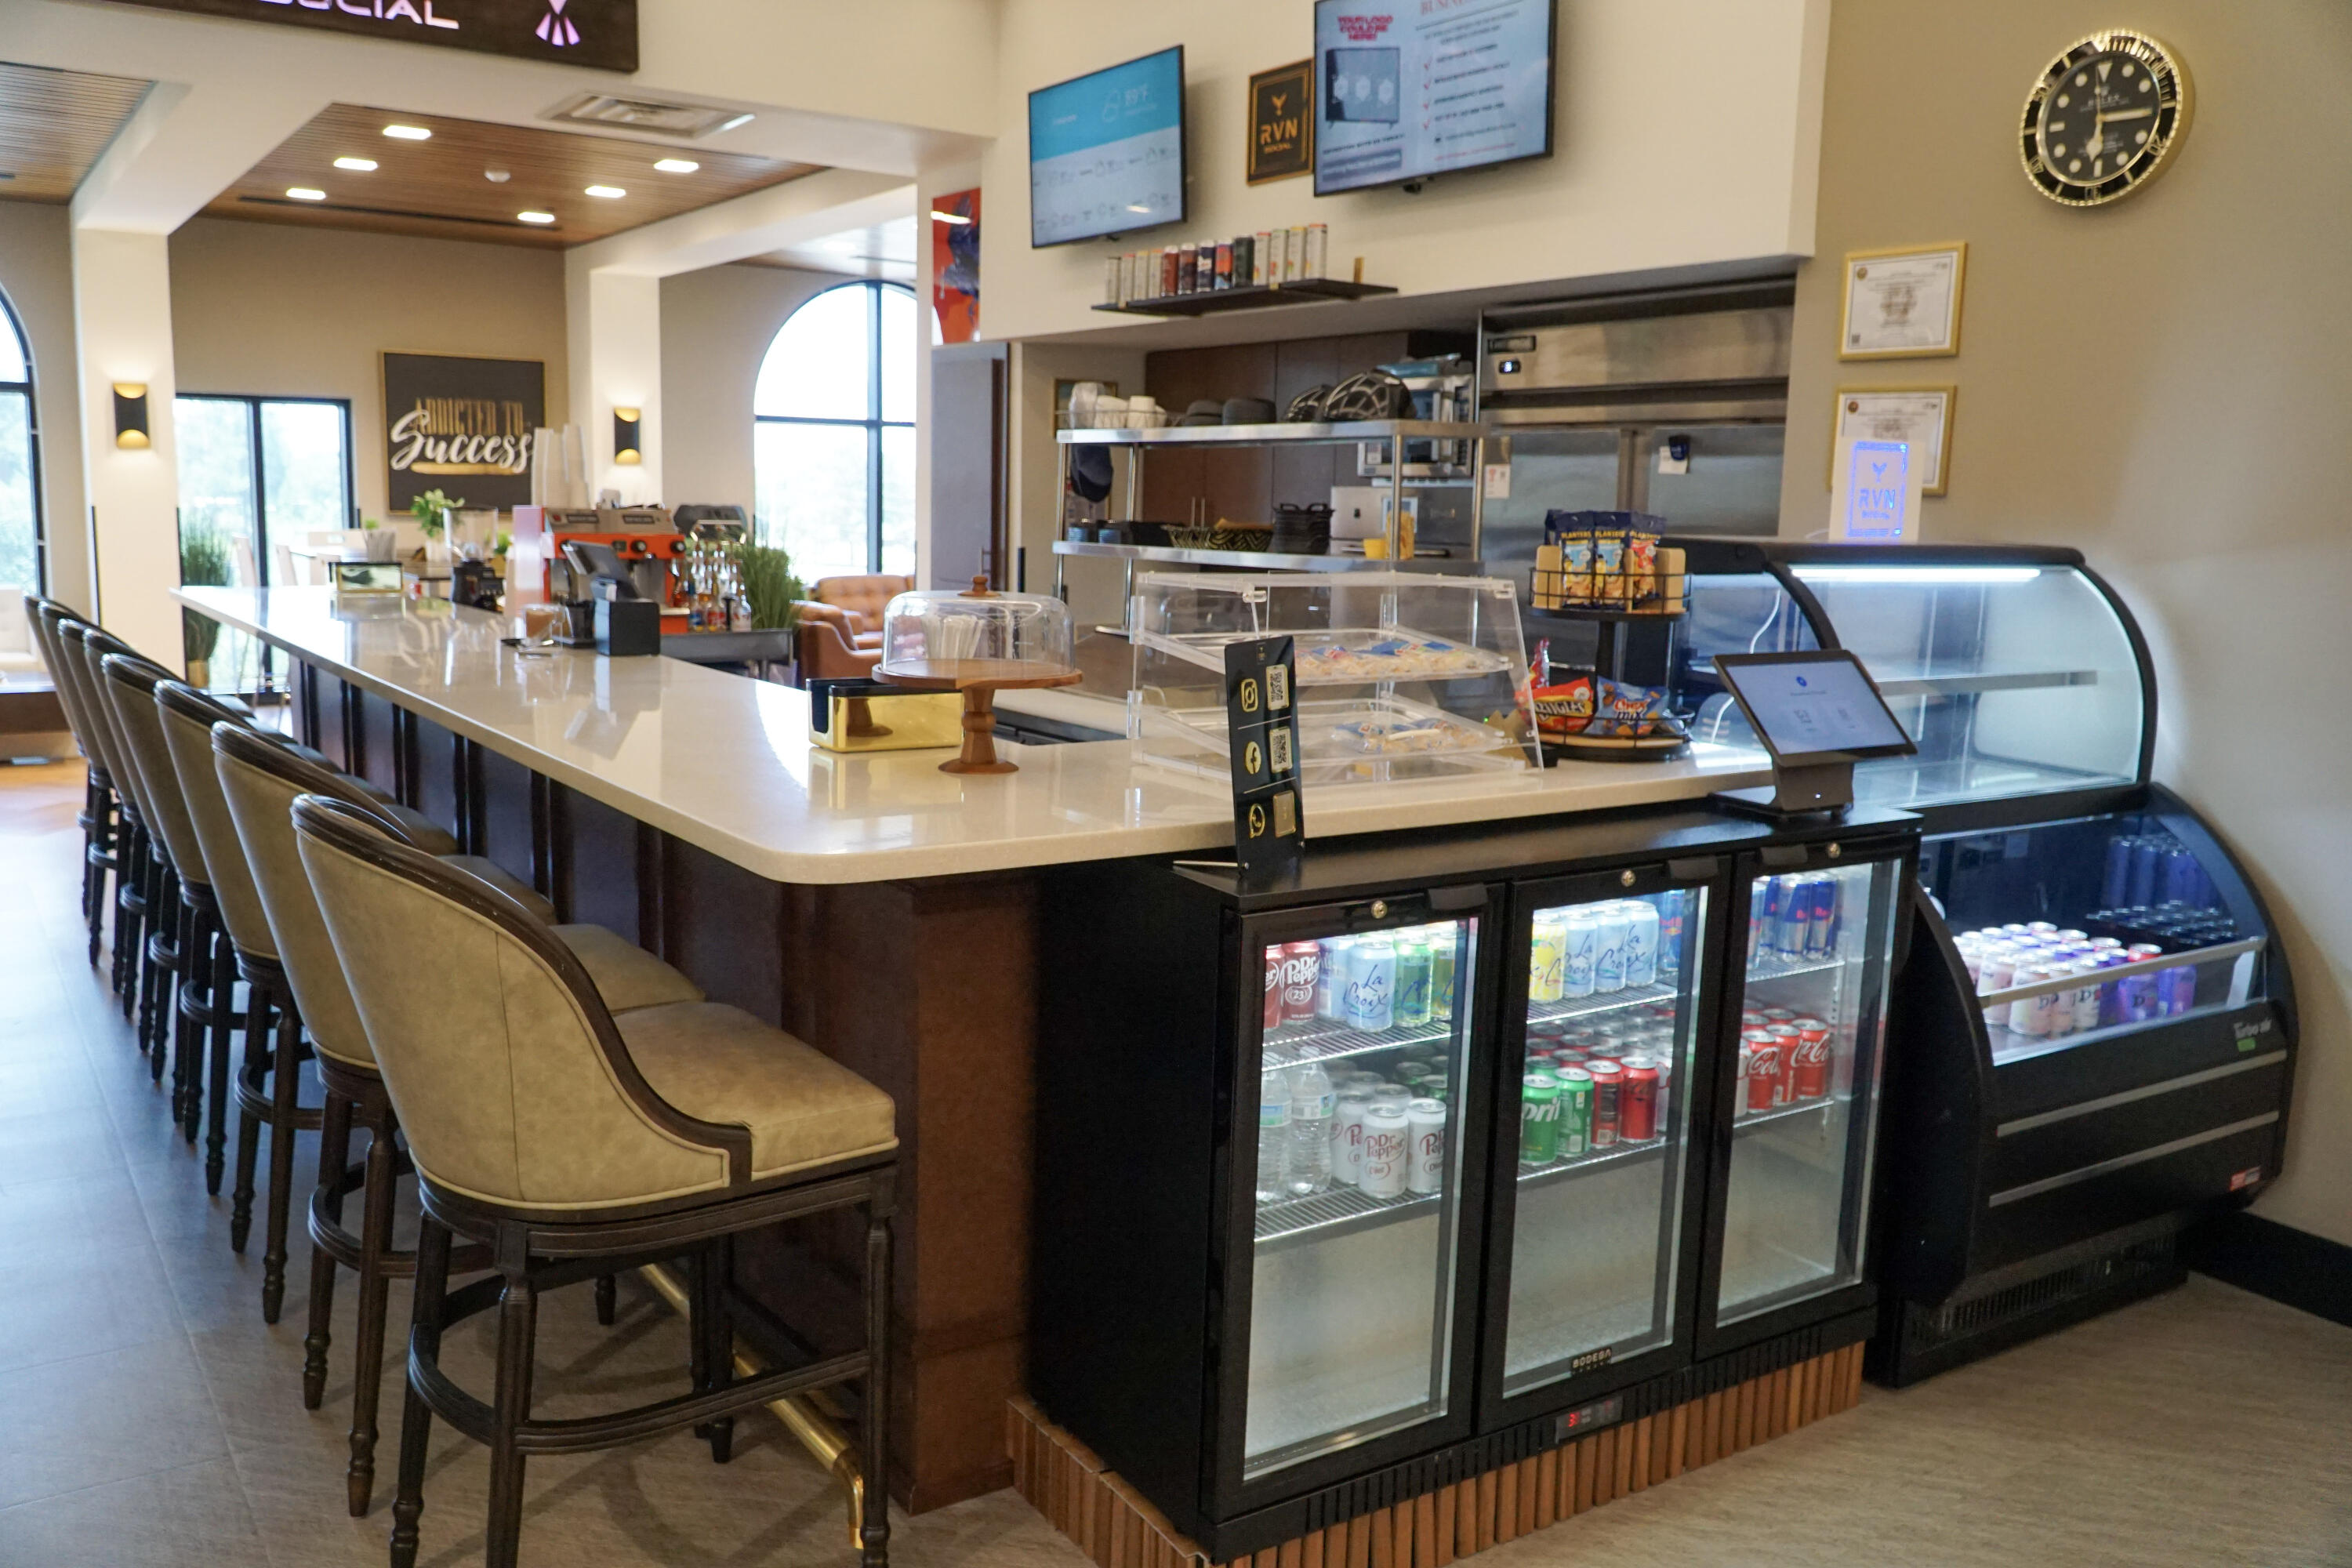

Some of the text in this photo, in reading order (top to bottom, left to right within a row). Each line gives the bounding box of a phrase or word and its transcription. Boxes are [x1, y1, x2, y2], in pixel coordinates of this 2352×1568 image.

[260, 0, 459, 30] CIAL
[1260, 118, 1298, 145] RVN
[390, 408, 532, 474] Success
[1858, 488, 1896, 510] RVN
[1281, 960, 1320, 985] Peppe
[1300, 956, 1316, 973] Dr
[1361, 964, 1385, 992] La
[1293, 989, 1305, 1000] 23
[1343, 981, 1388, 1012] Croix
[1364, 1135, 1405, 1160] Pepper
[1378, 1134, 1396, 1147] Dr
[1572, 1348, 1612, 1369] BODEGA
